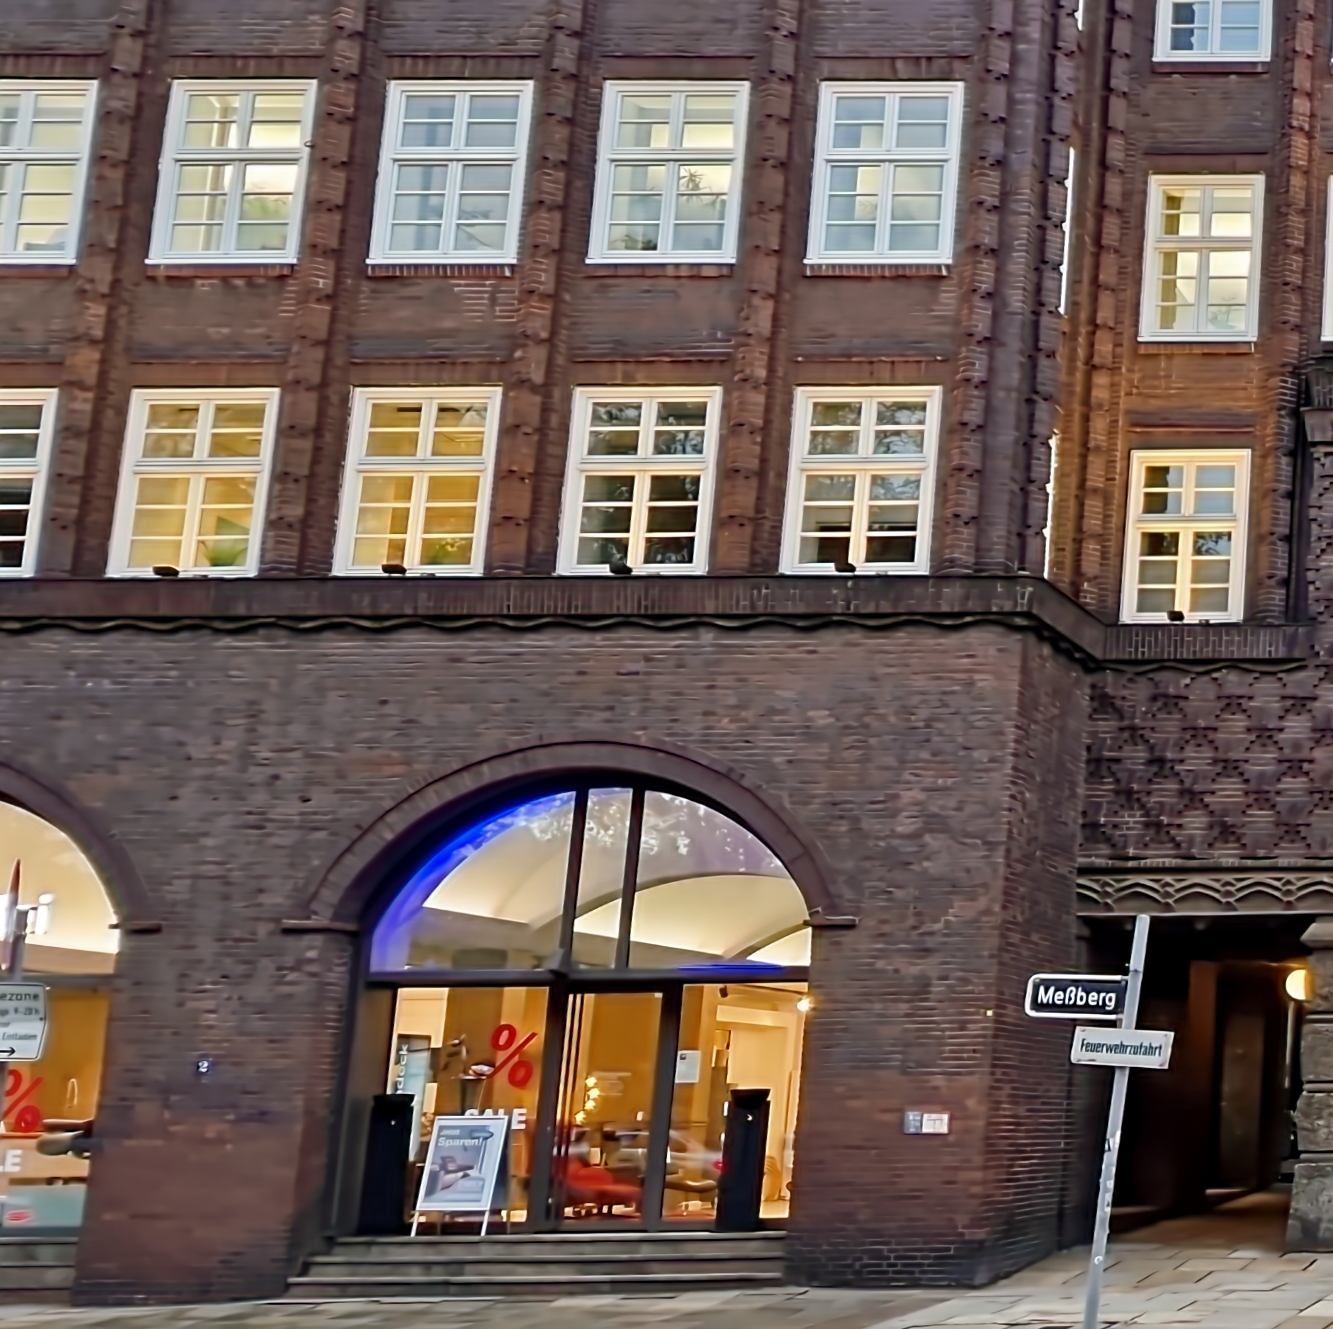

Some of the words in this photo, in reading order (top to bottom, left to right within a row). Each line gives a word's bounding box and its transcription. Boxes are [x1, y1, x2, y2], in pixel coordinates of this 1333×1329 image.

[1037, 984, 1117, 1011] Meßberg
[1079, 1038, 1163, 1058] Feuerwehrzufahrt
[198, 1060, 209, 1073] 2
